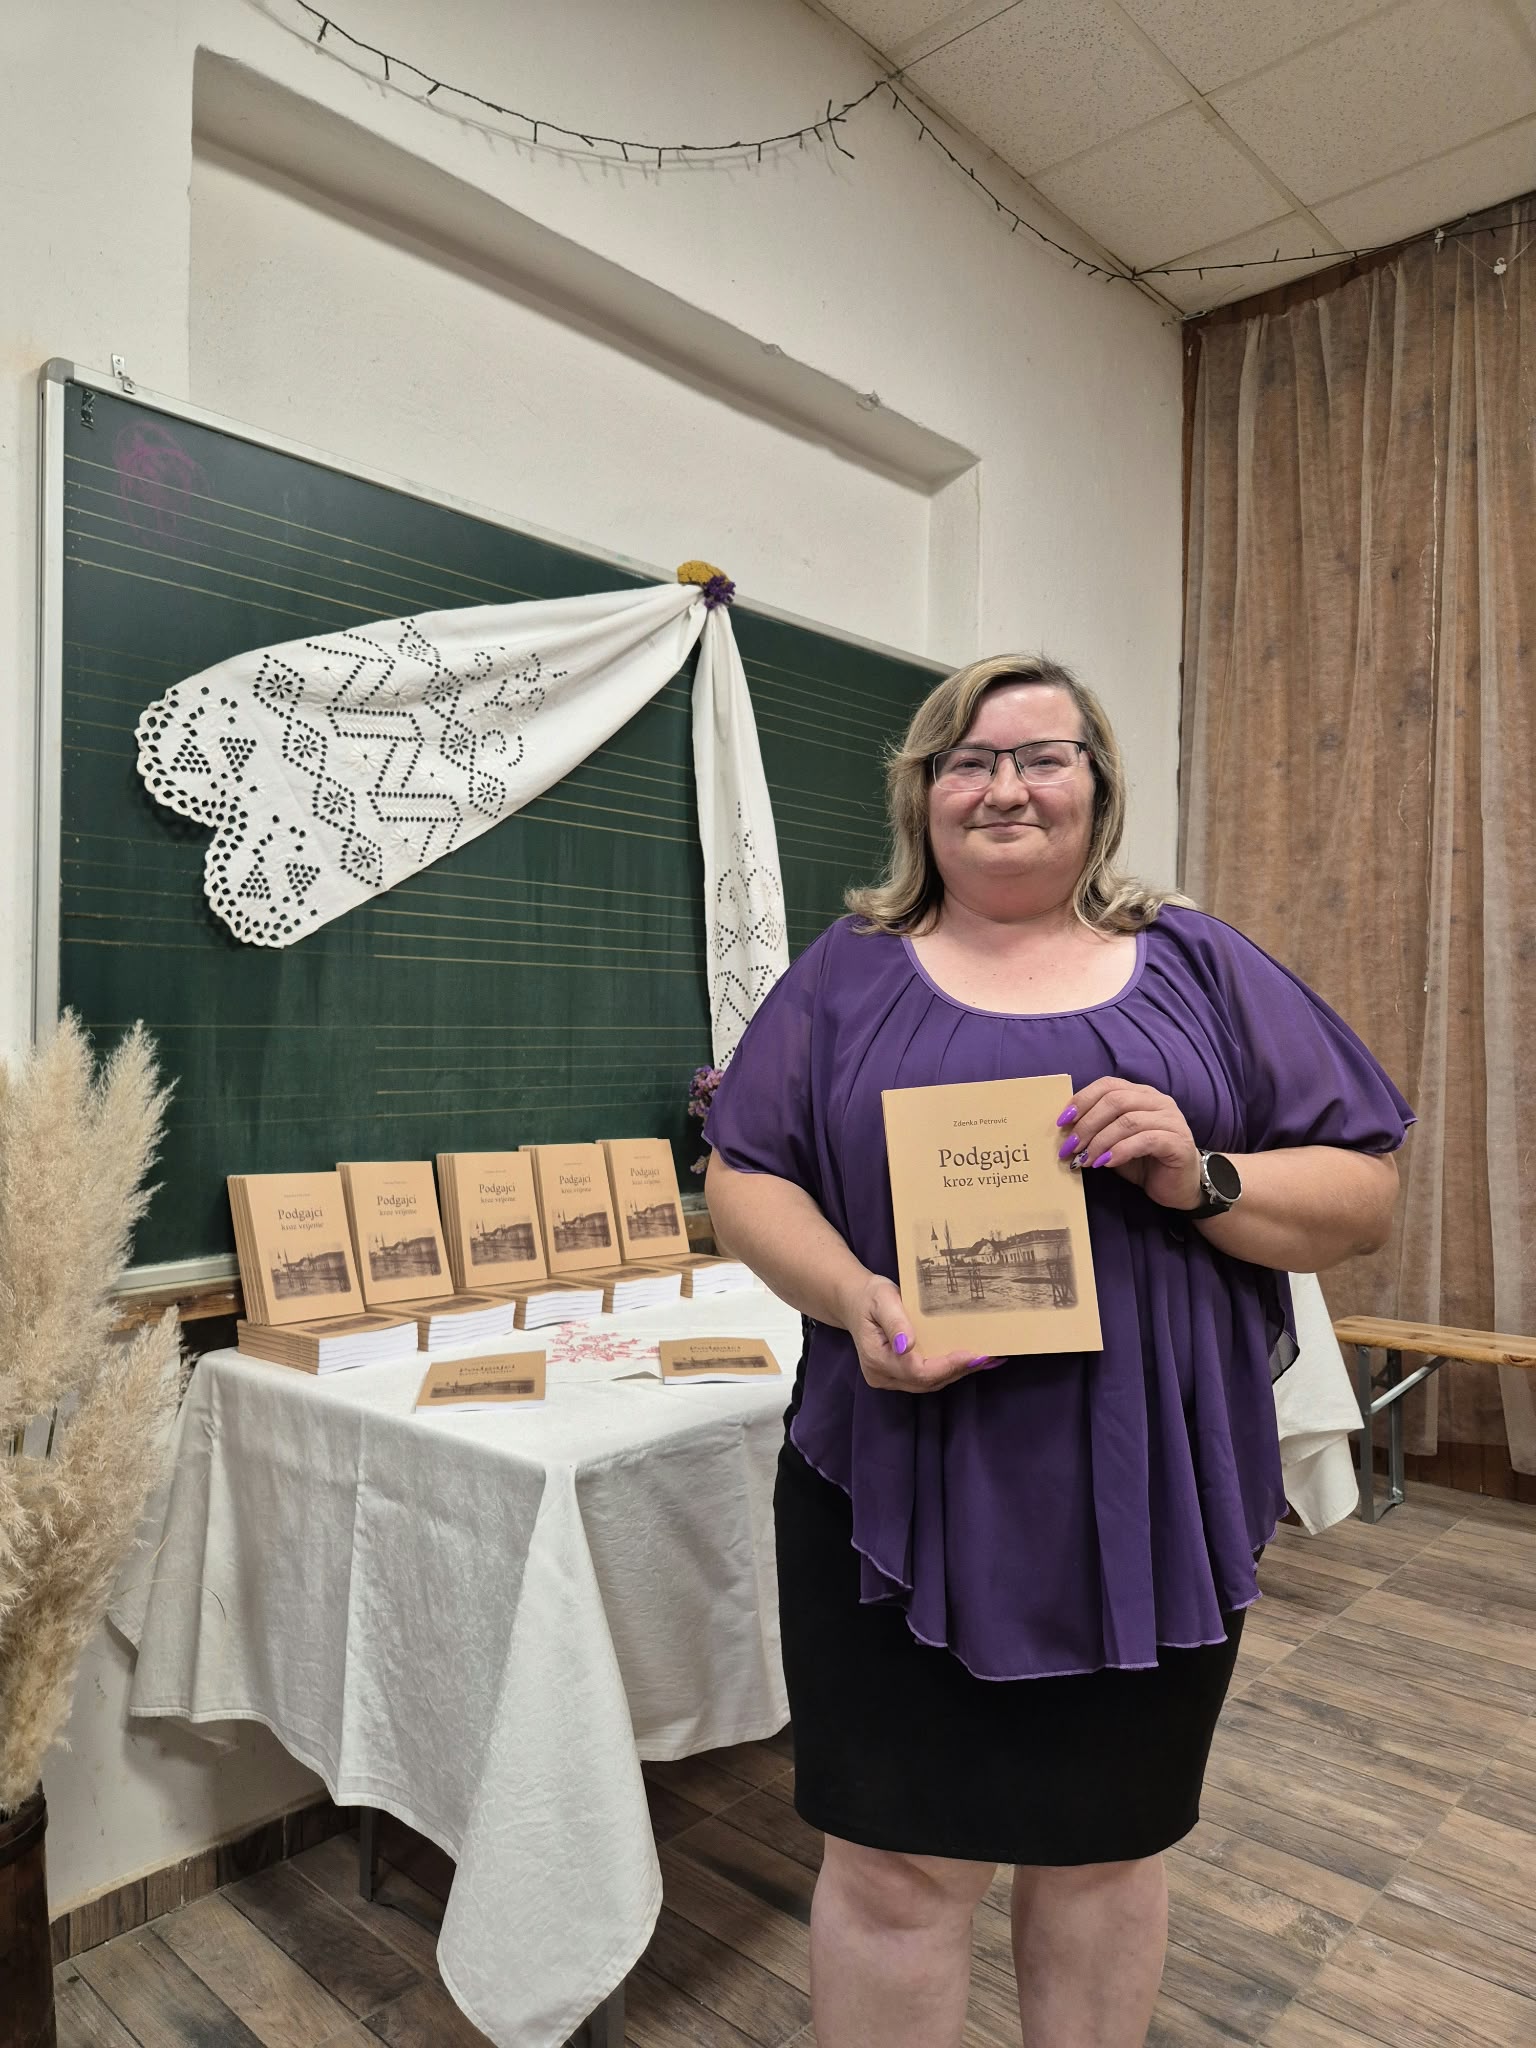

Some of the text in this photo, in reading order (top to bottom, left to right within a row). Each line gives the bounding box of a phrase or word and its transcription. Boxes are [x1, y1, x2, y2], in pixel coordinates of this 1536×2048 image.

[979, 1117, 1008, 1125] Petrović
[938, 1143, 1030, 1171] Podgajci
[560, 1174, 591, 1186] Podgajci
[943, 1172, 1029, 1188] kroz vrijeme
[479, 1182, 516, 1195] Podgajci
[377, 1194, 417, 1207] Podgajci
[278, 1207, 323, 1221] Podgajci
